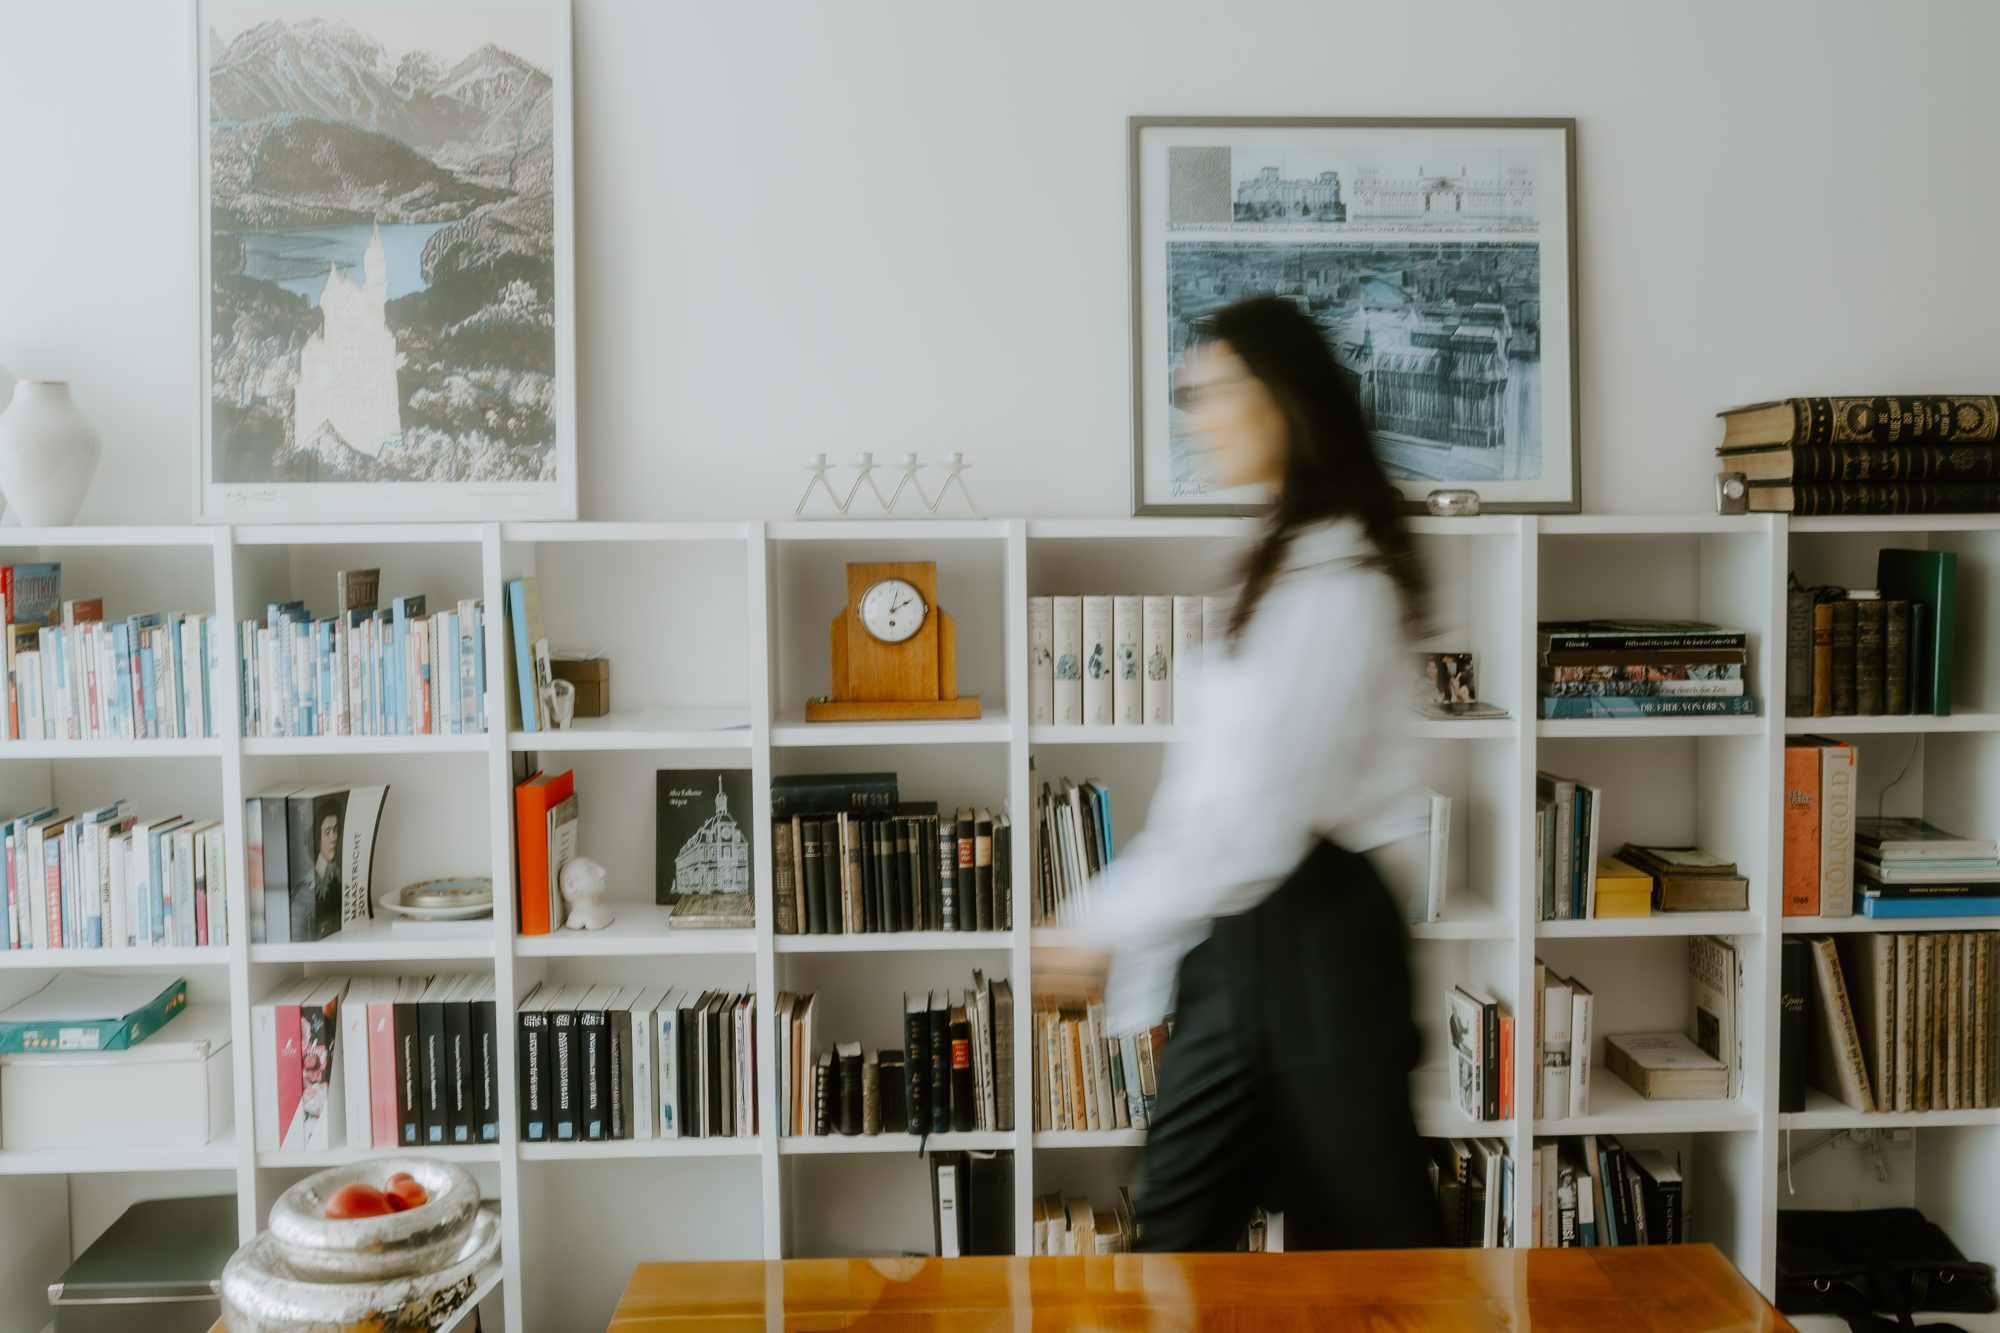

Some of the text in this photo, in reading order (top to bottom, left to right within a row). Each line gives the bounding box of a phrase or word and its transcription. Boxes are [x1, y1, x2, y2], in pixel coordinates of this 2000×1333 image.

[15, 575, 60, 603] SÜDTIROL
[1640, 703, 1655, 713] DIE
[1657, 703, 1681, 713] ERDE
[1682, 703, 1701, 712] VON
[1702, 703, 1726, 712] OBEN
[1826, 770, 1850, 900] KÖLNGOLD
[351, 832, 362, 921] MAASTRICHT
[358, 886, 366, 916] 2019
[1781, 993, 1804, 1009] Opus
[1561, 1209, 1575, 1240] Kunst
